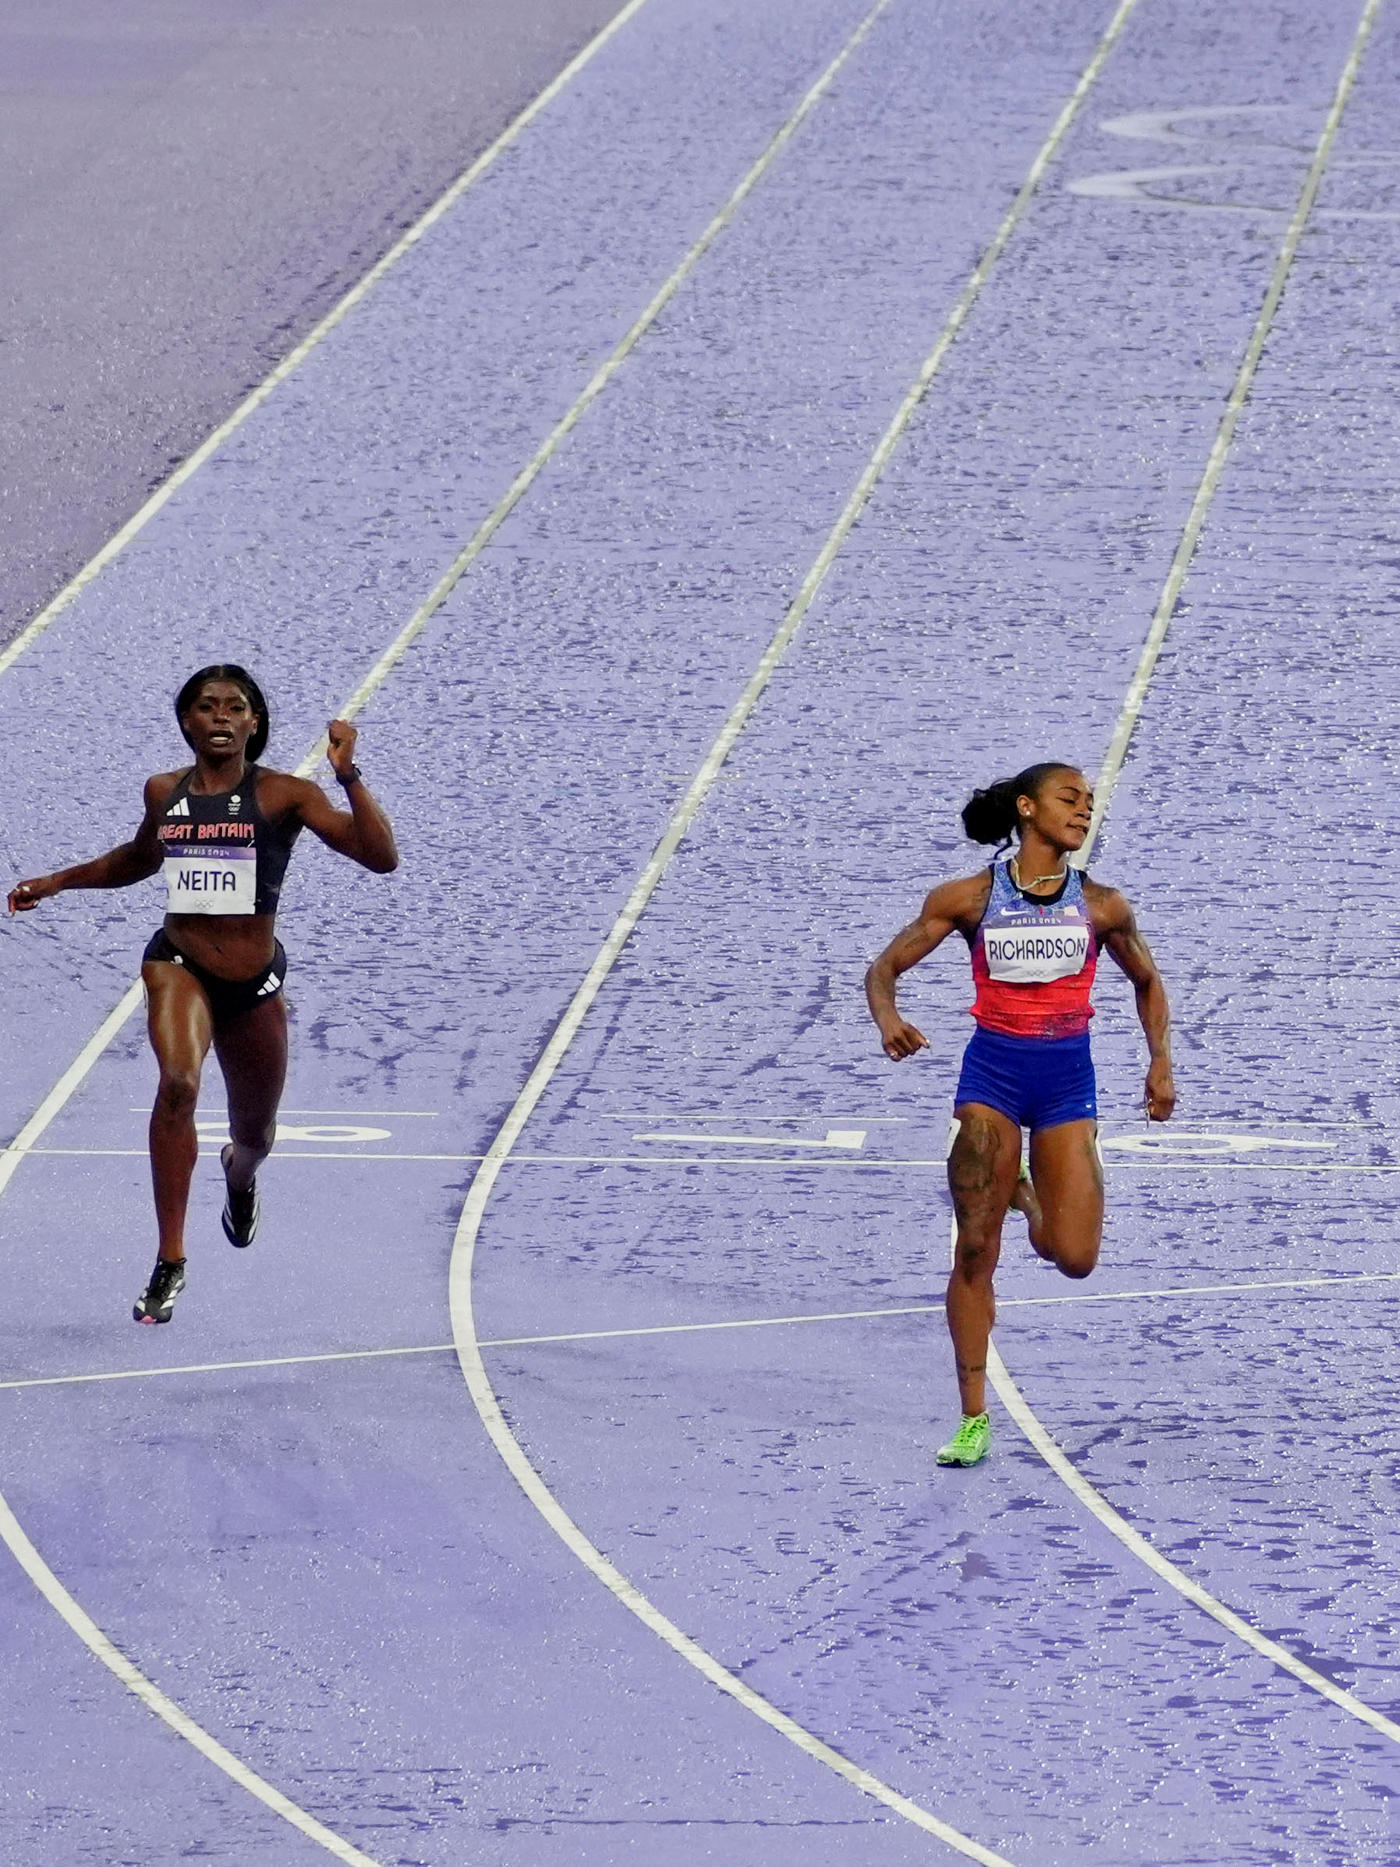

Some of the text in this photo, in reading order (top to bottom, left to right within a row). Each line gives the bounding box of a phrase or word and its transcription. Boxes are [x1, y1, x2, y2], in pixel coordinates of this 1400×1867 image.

[197, 822, 255, 839] BRITAIN
[183, 848, 206, 857] PARIS
[177, 870, 236, 892] NEITA
[1010, 918, 1037, 926] PARIS
[988, 938, 1086, 961] RICHARDSON
